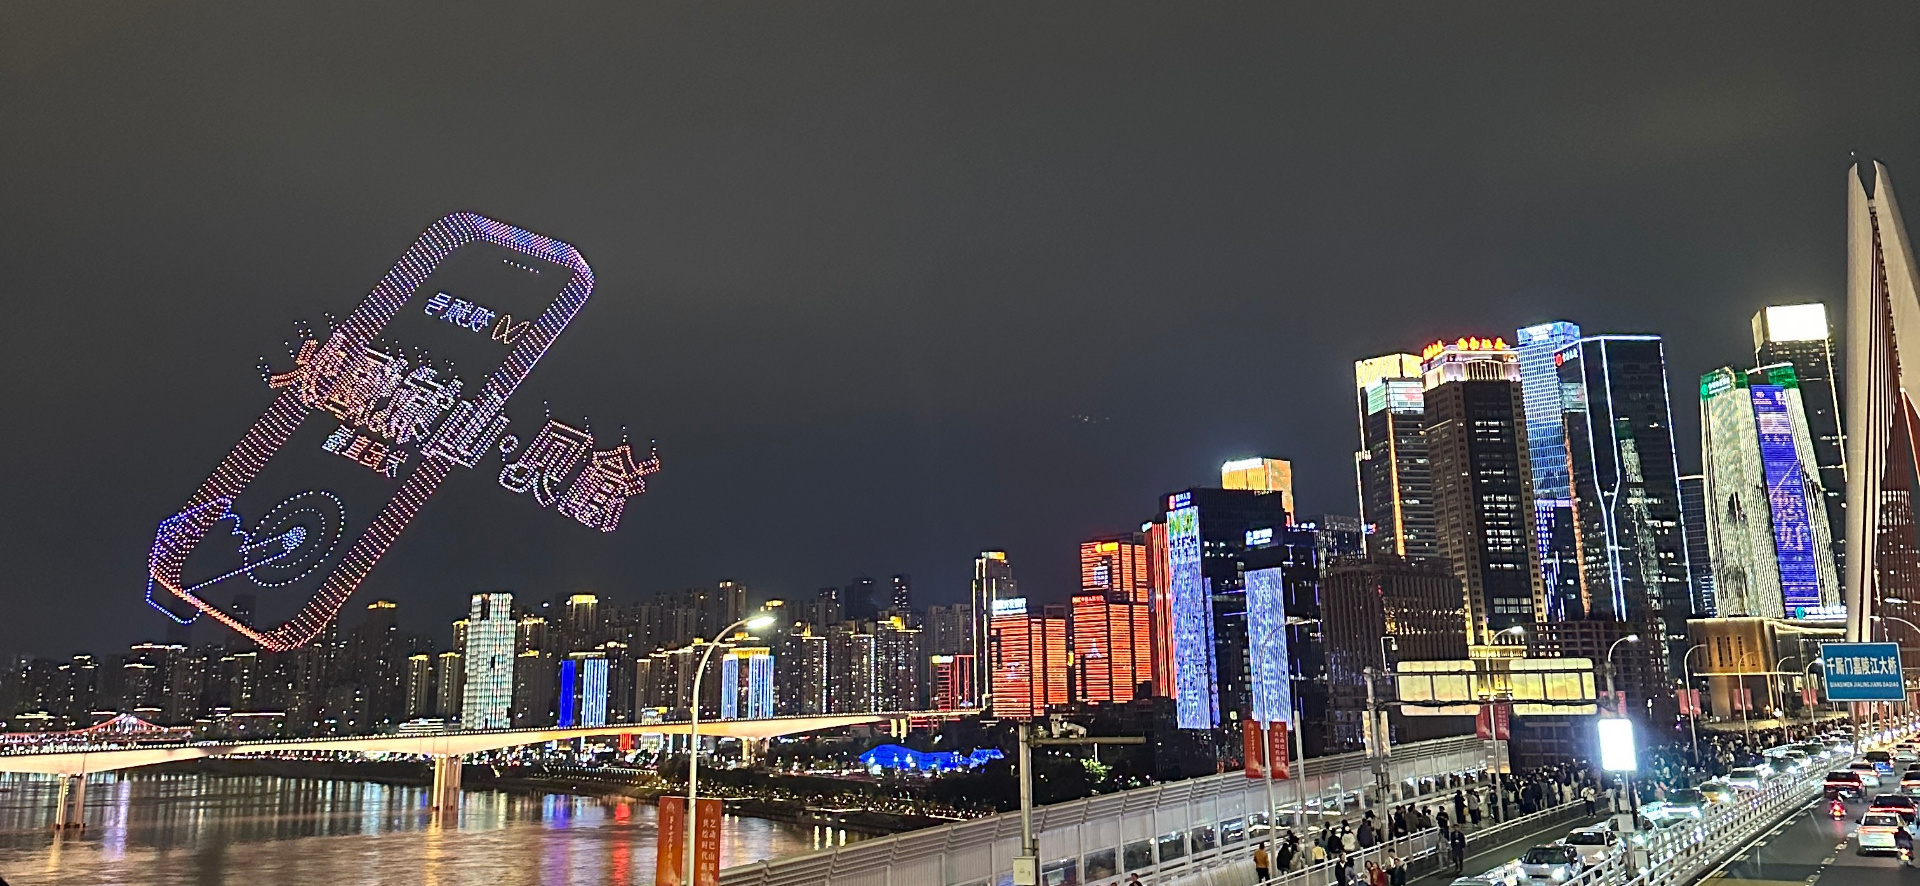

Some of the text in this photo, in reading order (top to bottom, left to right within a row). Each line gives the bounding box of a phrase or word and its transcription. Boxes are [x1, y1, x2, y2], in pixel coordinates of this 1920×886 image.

[1826, 656, 1897, 675] 千厮门嘉陵江大桥
